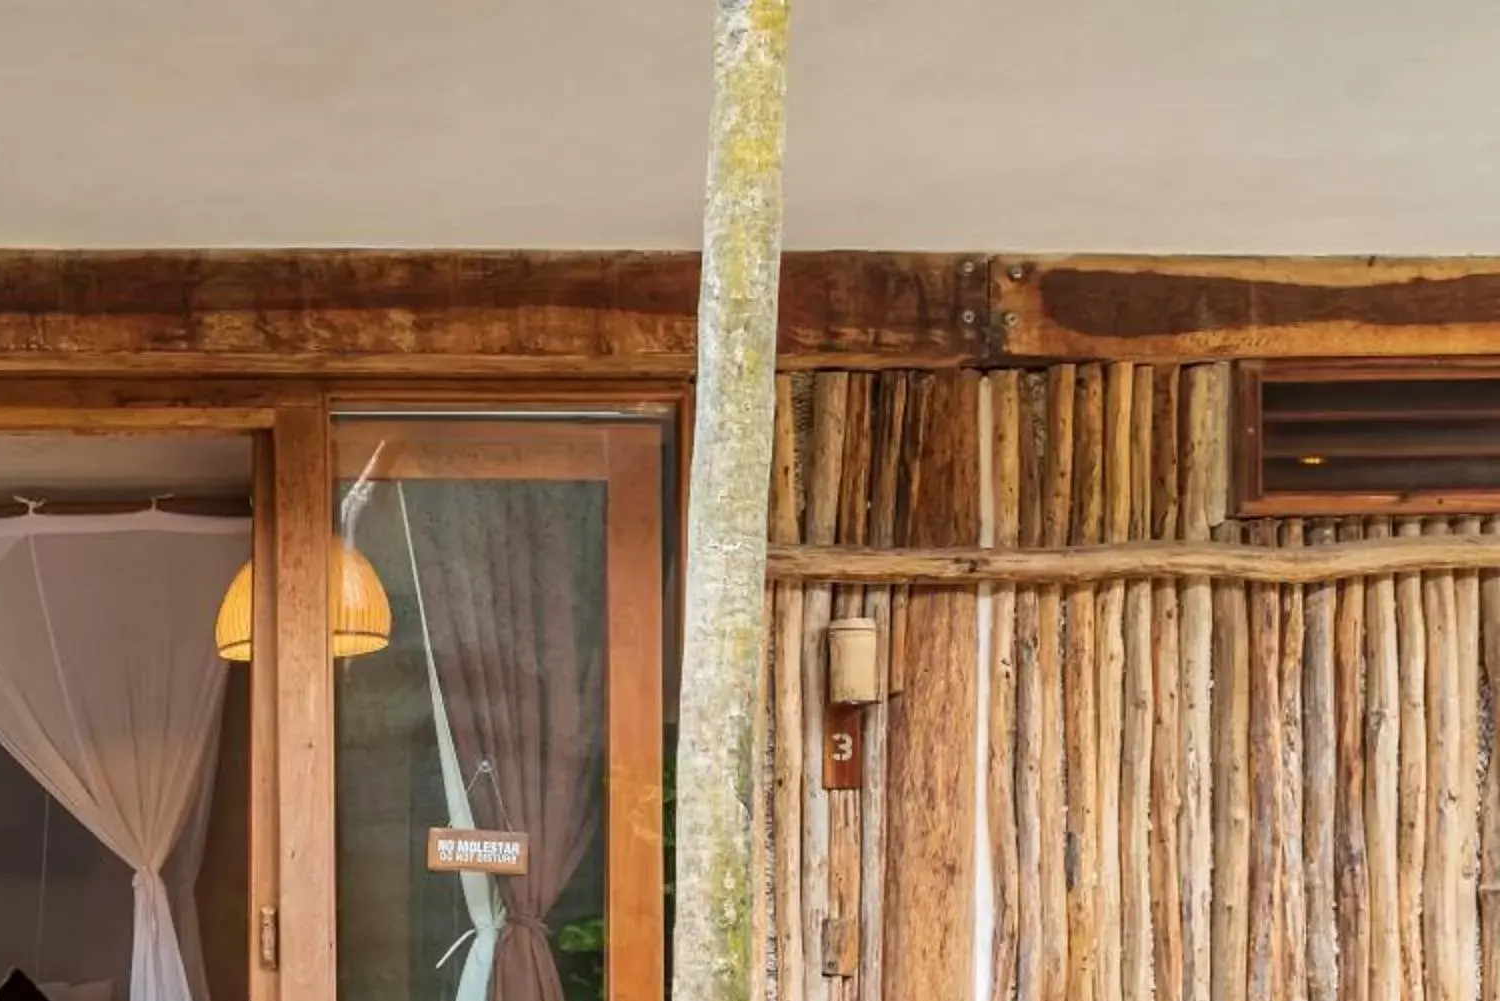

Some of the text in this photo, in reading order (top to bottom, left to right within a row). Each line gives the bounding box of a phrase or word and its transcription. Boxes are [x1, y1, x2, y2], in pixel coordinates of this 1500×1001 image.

[831, 733, 853, 760] 3
[437, 839, 519, 855] NO MOLESTAR
[439, 851, 453, 861] DO
[456, 852, 474, 863] NOT
